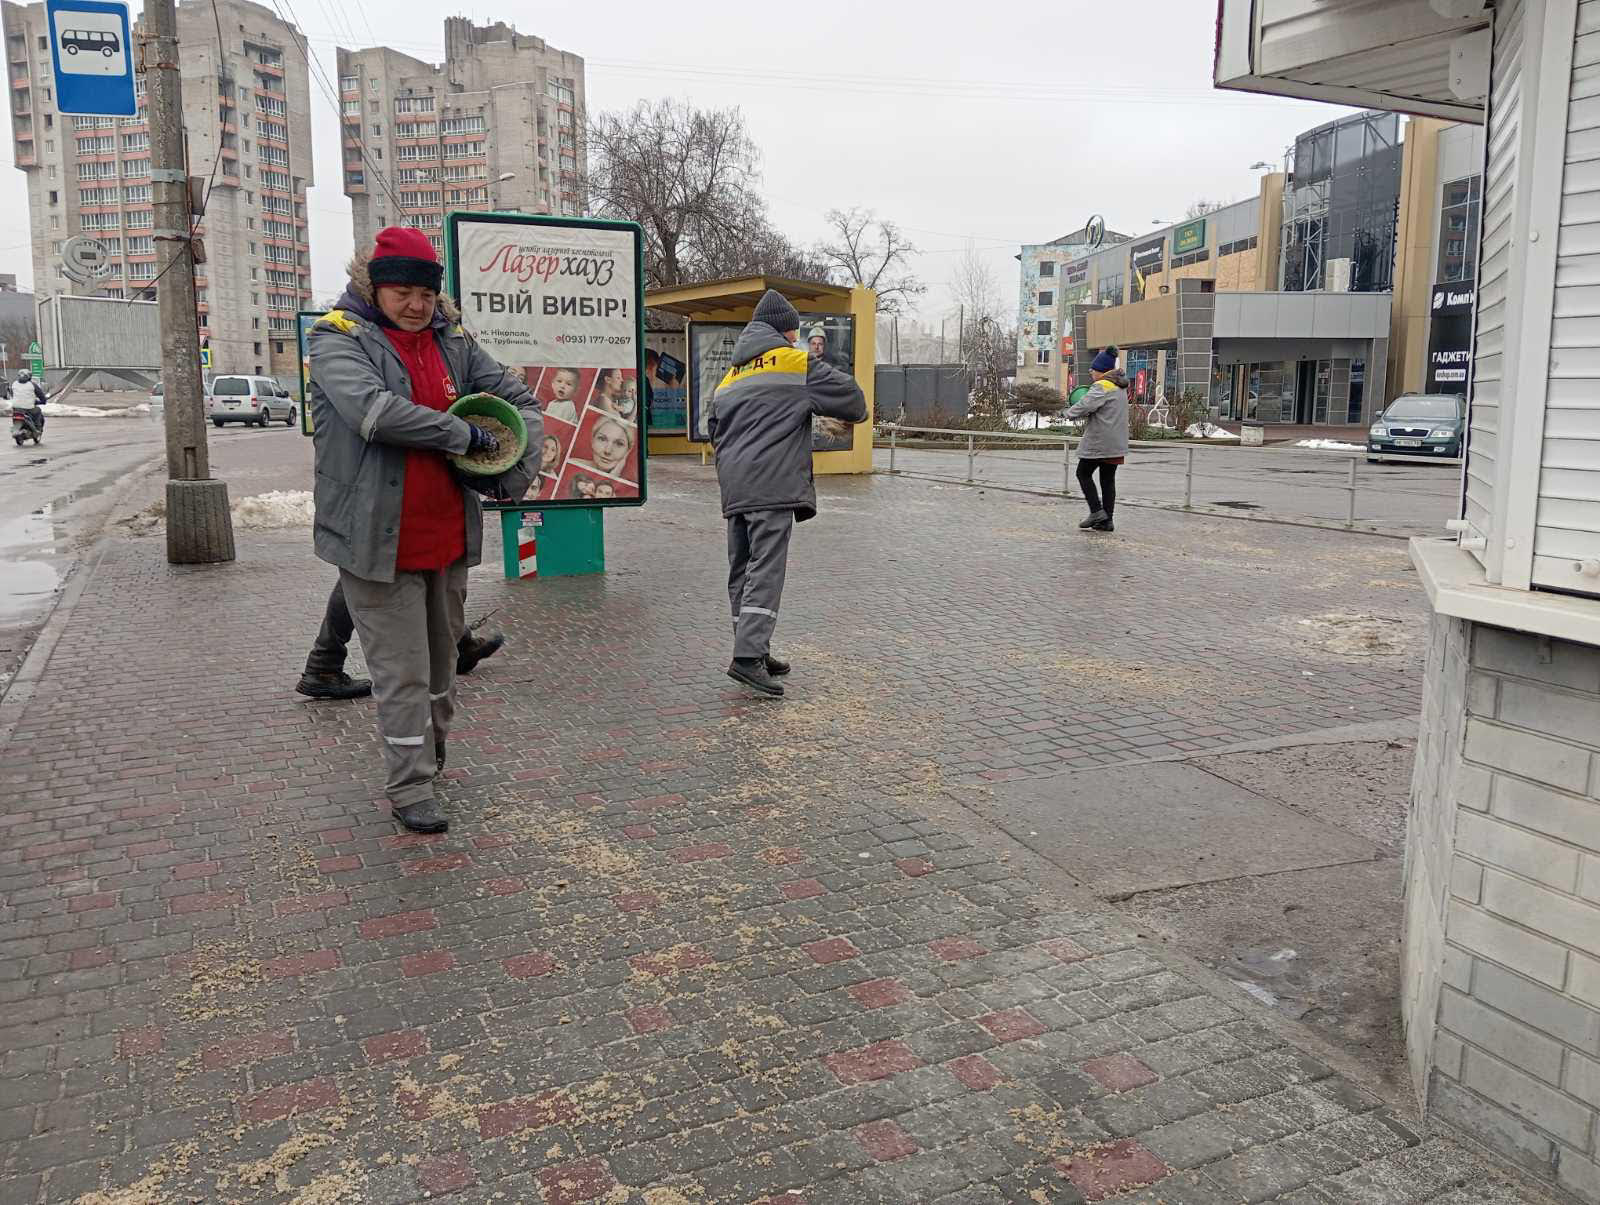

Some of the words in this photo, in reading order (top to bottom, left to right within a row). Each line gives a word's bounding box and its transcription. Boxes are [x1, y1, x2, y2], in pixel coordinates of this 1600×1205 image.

[480, 244, 615, 286] Лазерхауз
[470, 289, 533, 315] ТВІЙ
[542, 295, 628, 318] ВИБІР!
[561, 335, 587, 345] (093)
[589, 335, 632, 345] 177-0267
